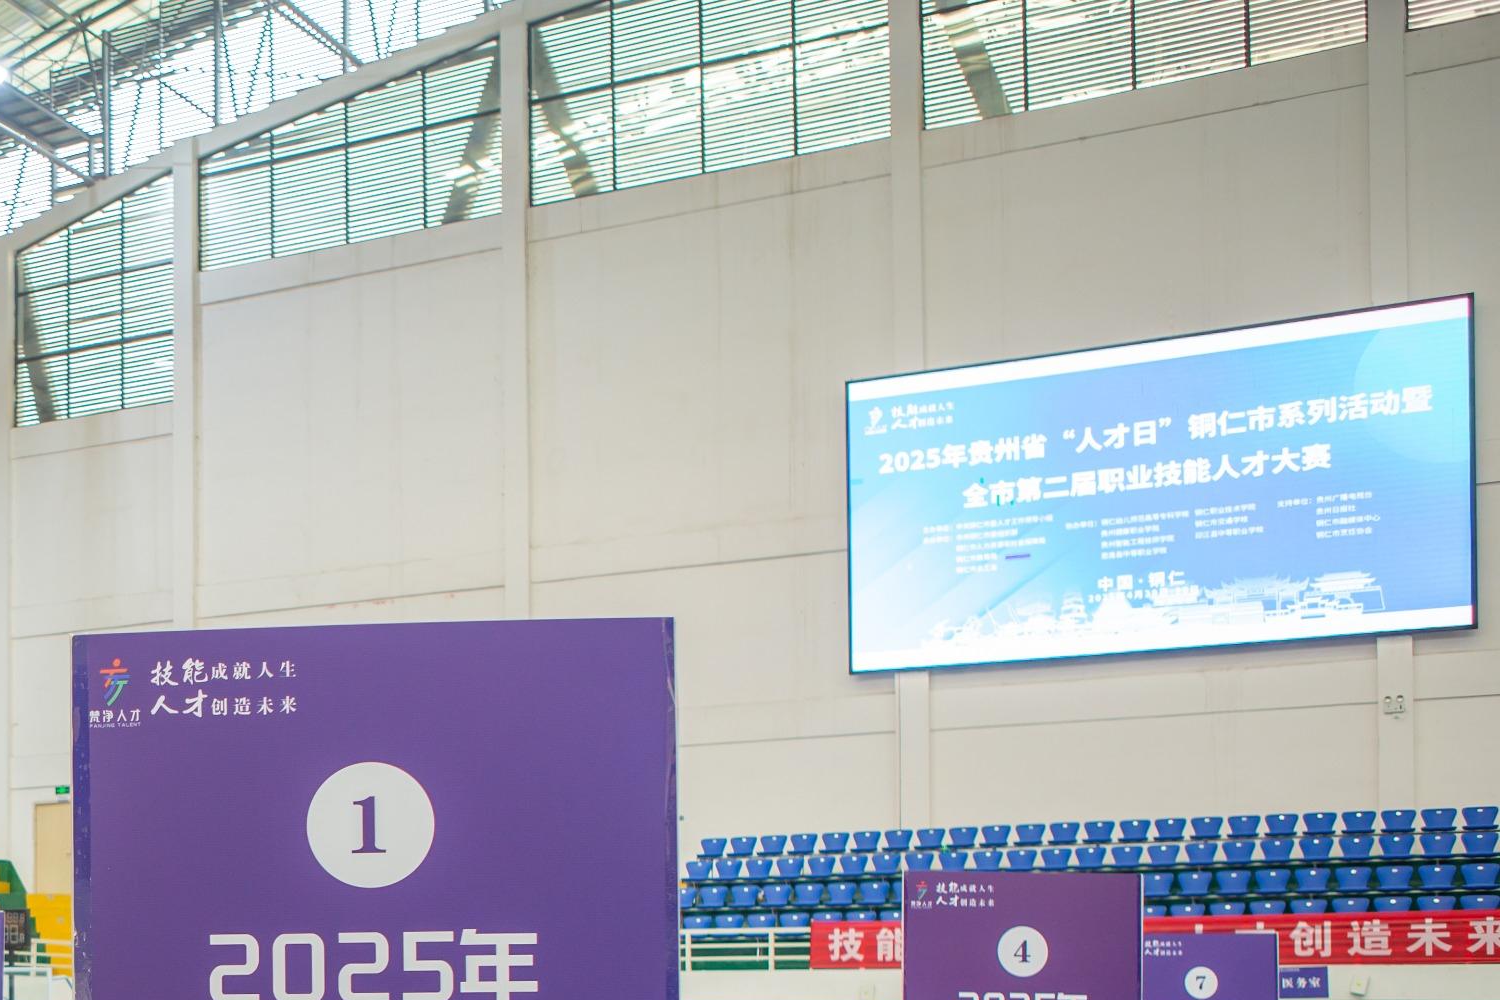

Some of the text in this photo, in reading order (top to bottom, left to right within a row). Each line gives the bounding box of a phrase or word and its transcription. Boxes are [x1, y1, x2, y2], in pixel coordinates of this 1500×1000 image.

[962, 443, 1332, 508] 全市第二届职业技能人才大赛
[151, 657, 297, 686] 技能成就人生
[150, 689, 297, 718] 人才创造未来
[351, 795, 387, 854] 1
[1013, 939, 1031, 964] 4
[1195, 975, 1206, 991] 7
